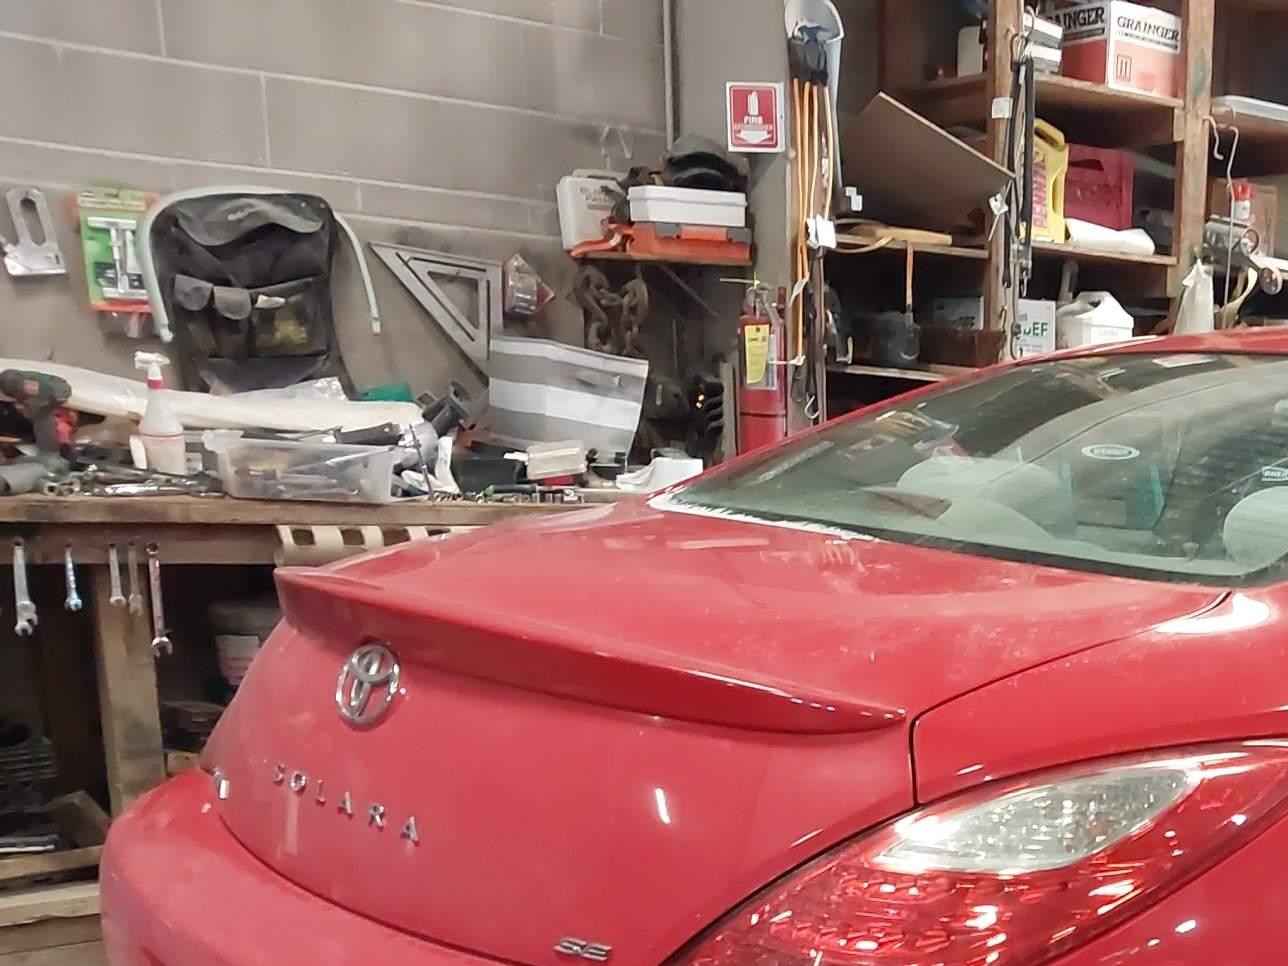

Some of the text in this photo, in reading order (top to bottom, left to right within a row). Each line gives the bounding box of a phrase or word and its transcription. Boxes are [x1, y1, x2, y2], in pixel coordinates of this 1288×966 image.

[1117, 16, 1180, 41] GRAINGER
[273, 763, 419, 843] SOLARA
[553, 937, 613, 961] SE
